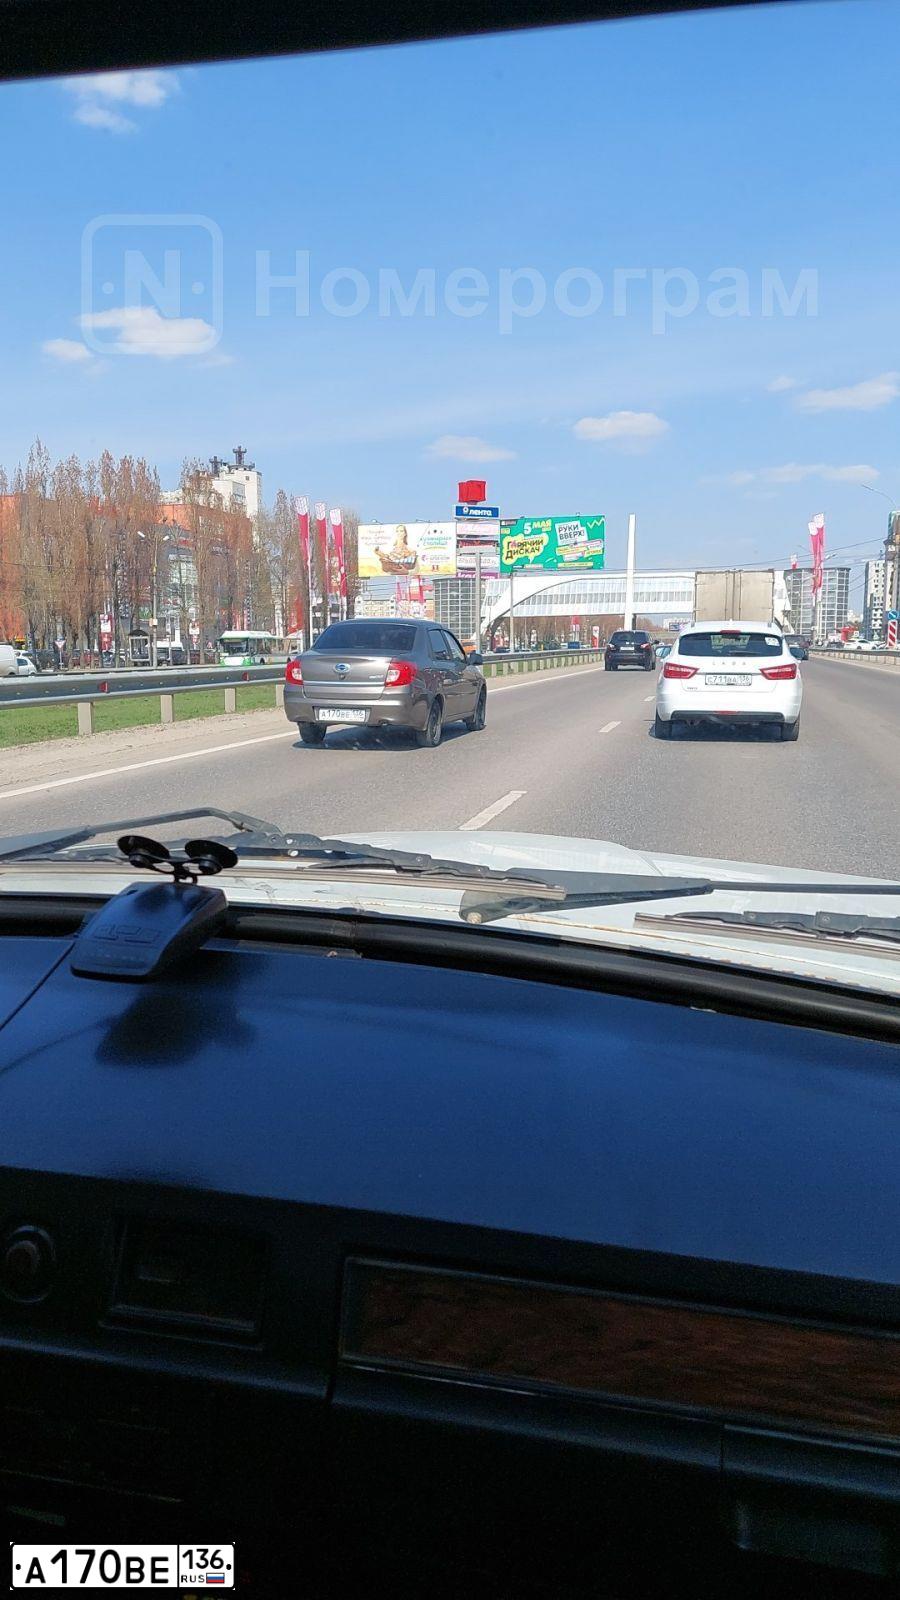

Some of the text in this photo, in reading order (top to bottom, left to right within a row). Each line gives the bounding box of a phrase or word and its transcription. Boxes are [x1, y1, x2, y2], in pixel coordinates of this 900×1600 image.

[523, 522, 532, 535] 5
[532, 518, 552, 529] МАЯ
[558, 524, 579, 533] РУКИ
